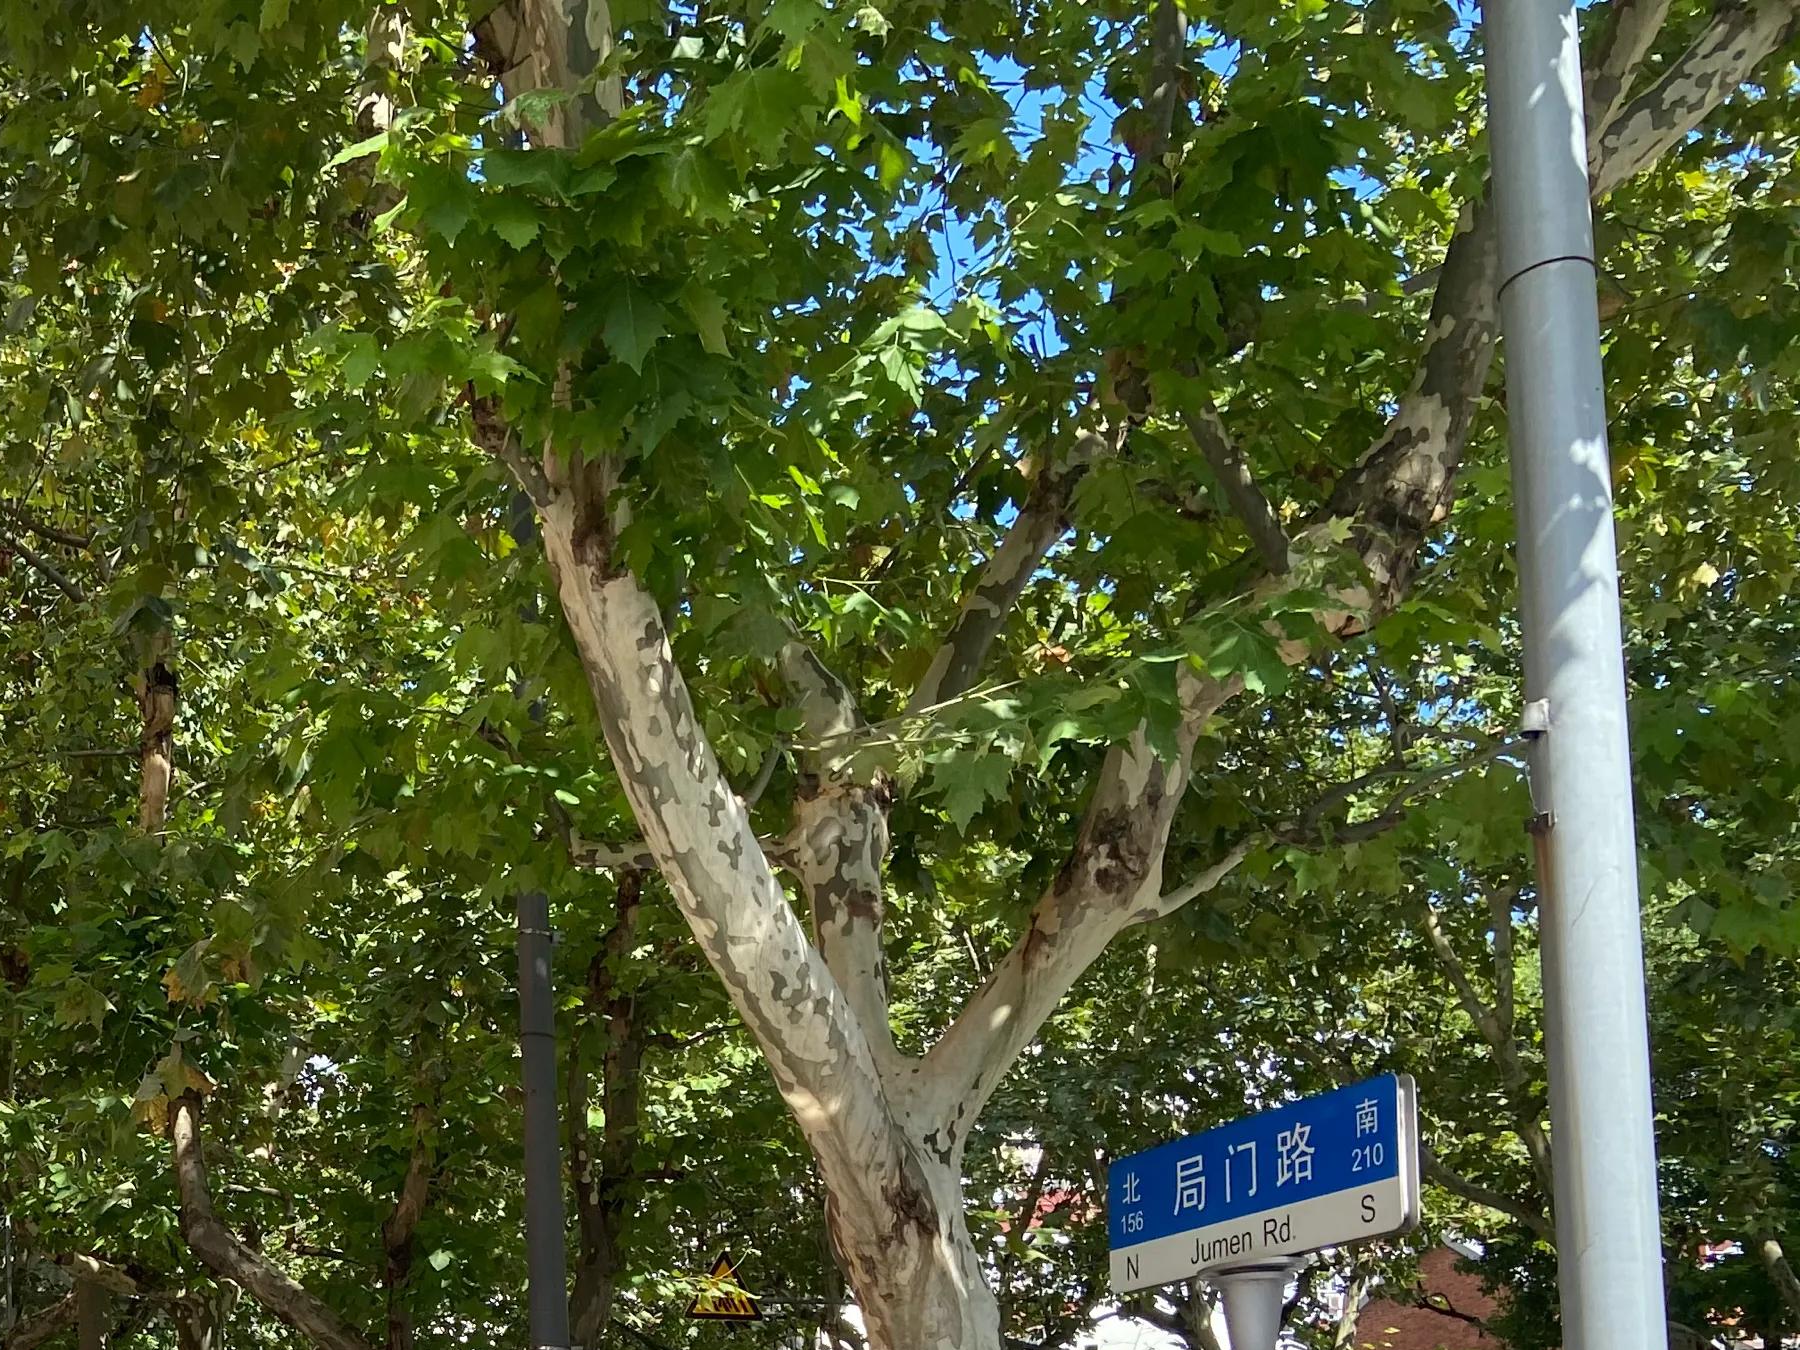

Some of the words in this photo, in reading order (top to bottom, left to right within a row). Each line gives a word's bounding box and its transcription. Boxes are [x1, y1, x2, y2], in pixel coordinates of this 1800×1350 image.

[1120, 1211, 1144, 1234] 156
[1352, 1143, 1383, 1172] 210
[1123, 1173, 1140, 1206] 北
[1174, 1122, 1315, 1216] 局门路
[1356, 1098, 1378, 1138] 南
[1126, 1255, 1139, 1281] N
[1191, 1230, 1252, 1265] Jumen
[1361, 1194, 1376, 1224] S
